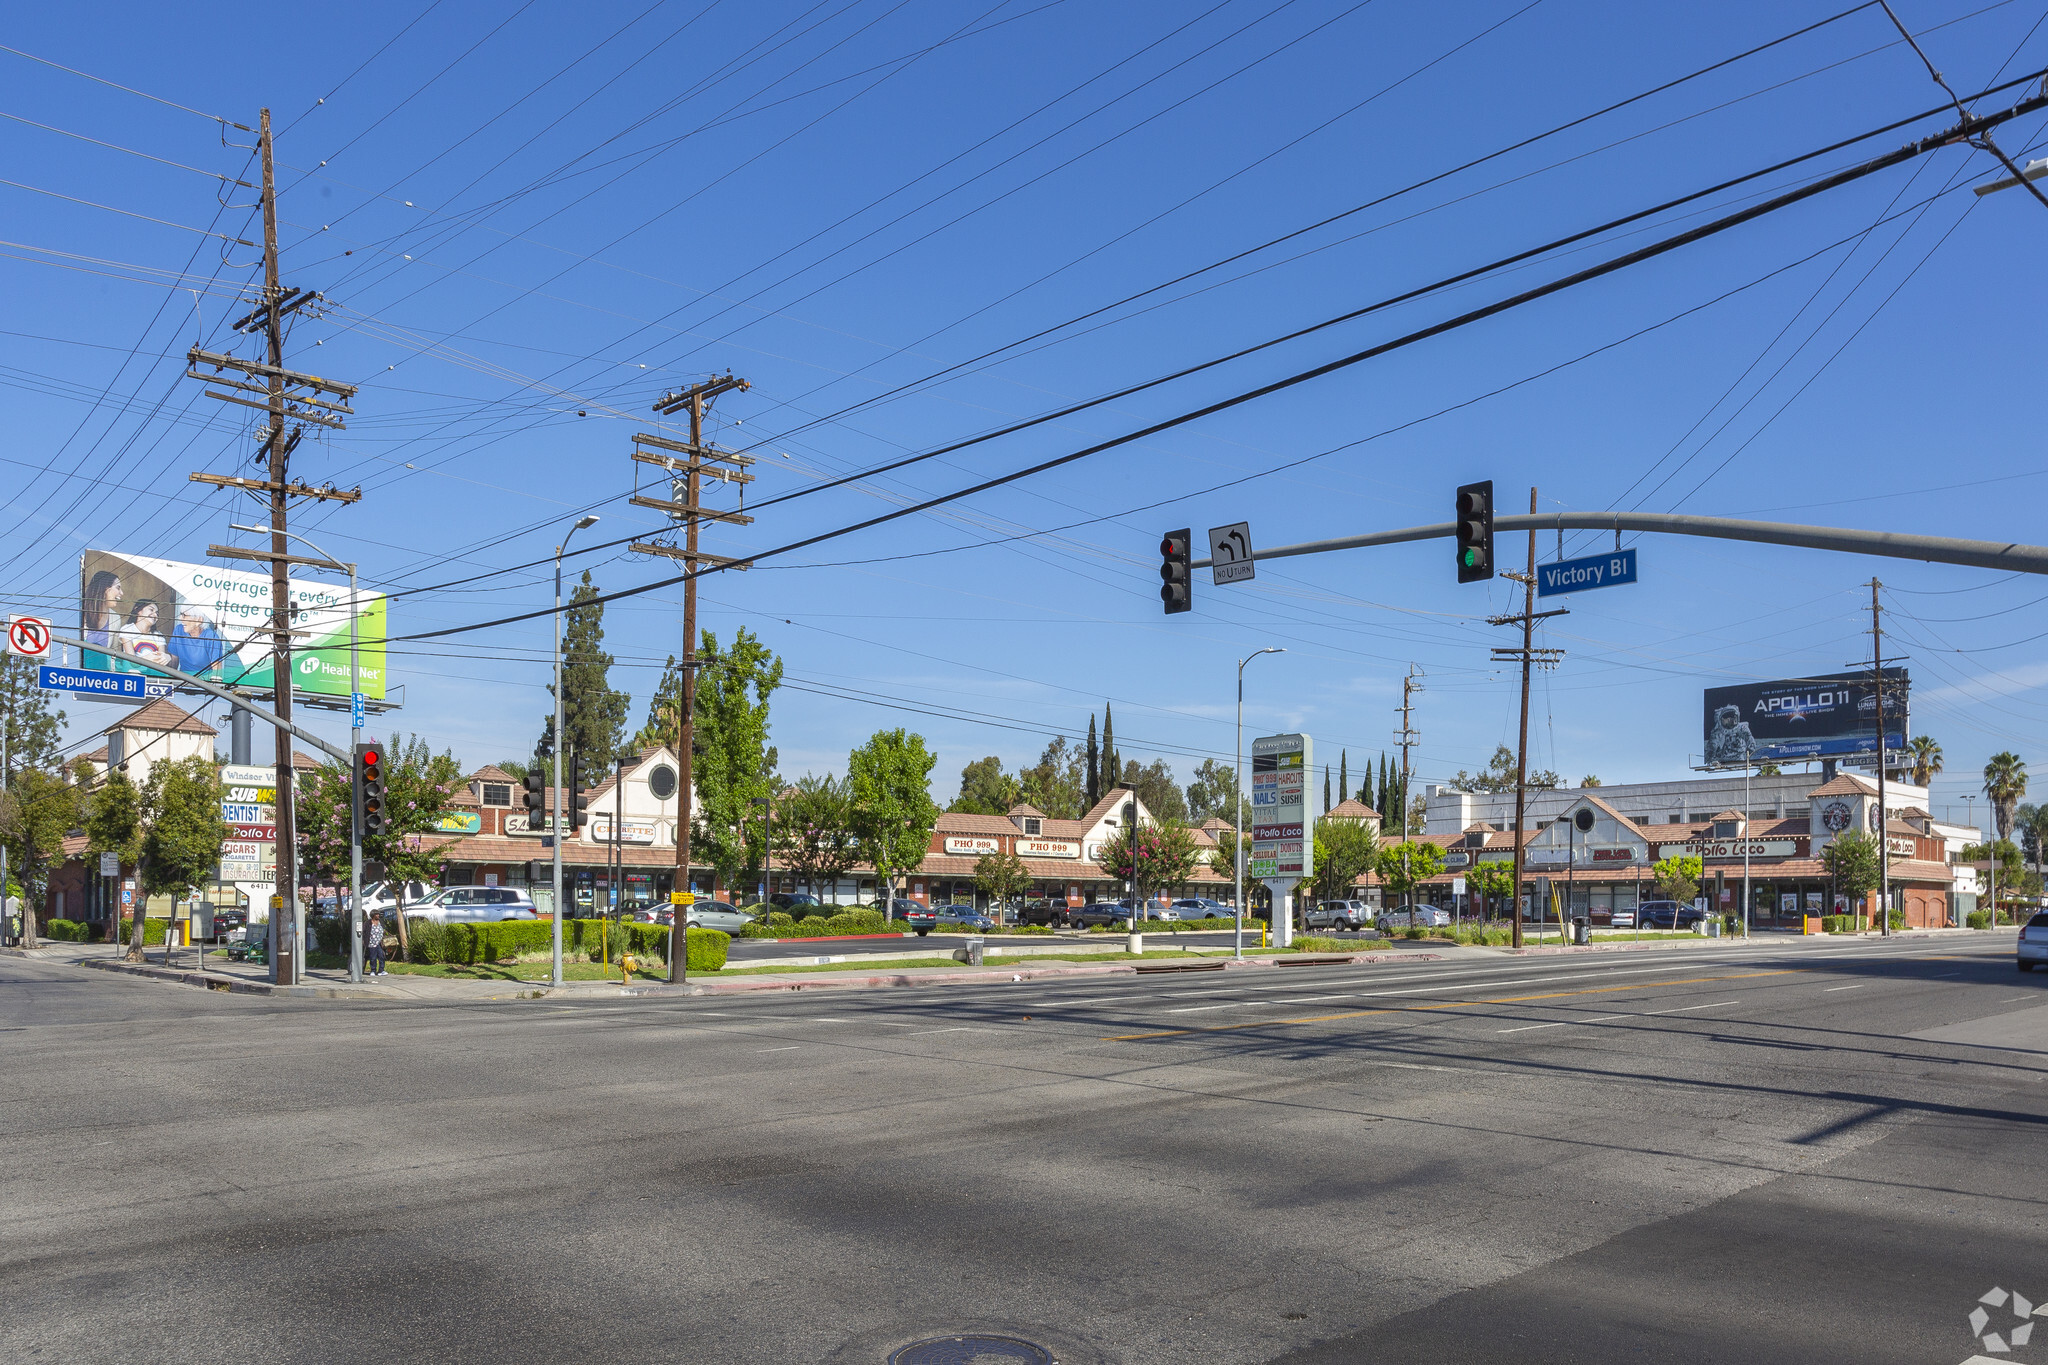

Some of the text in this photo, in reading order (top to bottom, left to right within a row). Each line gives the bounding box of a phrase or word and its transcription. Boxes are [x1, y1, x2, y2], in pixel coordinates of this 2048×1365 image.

[1217, 566, 1250, 578] NO U TURN
[1546, 558, 1626, 587] Victory Bl
[193, 574, 268, 598] Coverage
[299, 592, 339, 608] every
[215, 600, 259, 618] stage
[321, 662, 351, 677] Healt
[48, 672, 118, 691] Sepulveda
[124, 680, 137, 692] Bl
[1754, 690, 1849, 713] APOLLO 11
[1845, 756, 1892, 766] REGENY
[227, 771, 263, 781] Windsor
[1279, 773, 1304, 784] HAIRCUTS
[226, 787, 276, 802] SUBW
[1254, 792, 1276, 805] NAILS
[1281, 794, 1302, 804] SUSHI
[223, 805, 258, 822] DENTIST
[233, 827, 263, 838] Pollo
[596, 826, 654, 835] CIGRETTE
[1260, 828, 1280, 837] Pollo
[1282, 827, 1302, 837] Loco
[224, 844, 256, 854] CIGARS
[1052, 844, 1067, 852] 999
[1280, 843, 1302, 853] DONUTS
[1696, 844, 1727, 856] Pollo
[1732, 844, 1765, 855] Loco
[1903, 840, 1913, 853] Loco
[1254, 851, 1276, 859] CELLULAR
[1254, 860, 1276, 868] BOBA
[223, 870, 258, 880] INSURANCE
